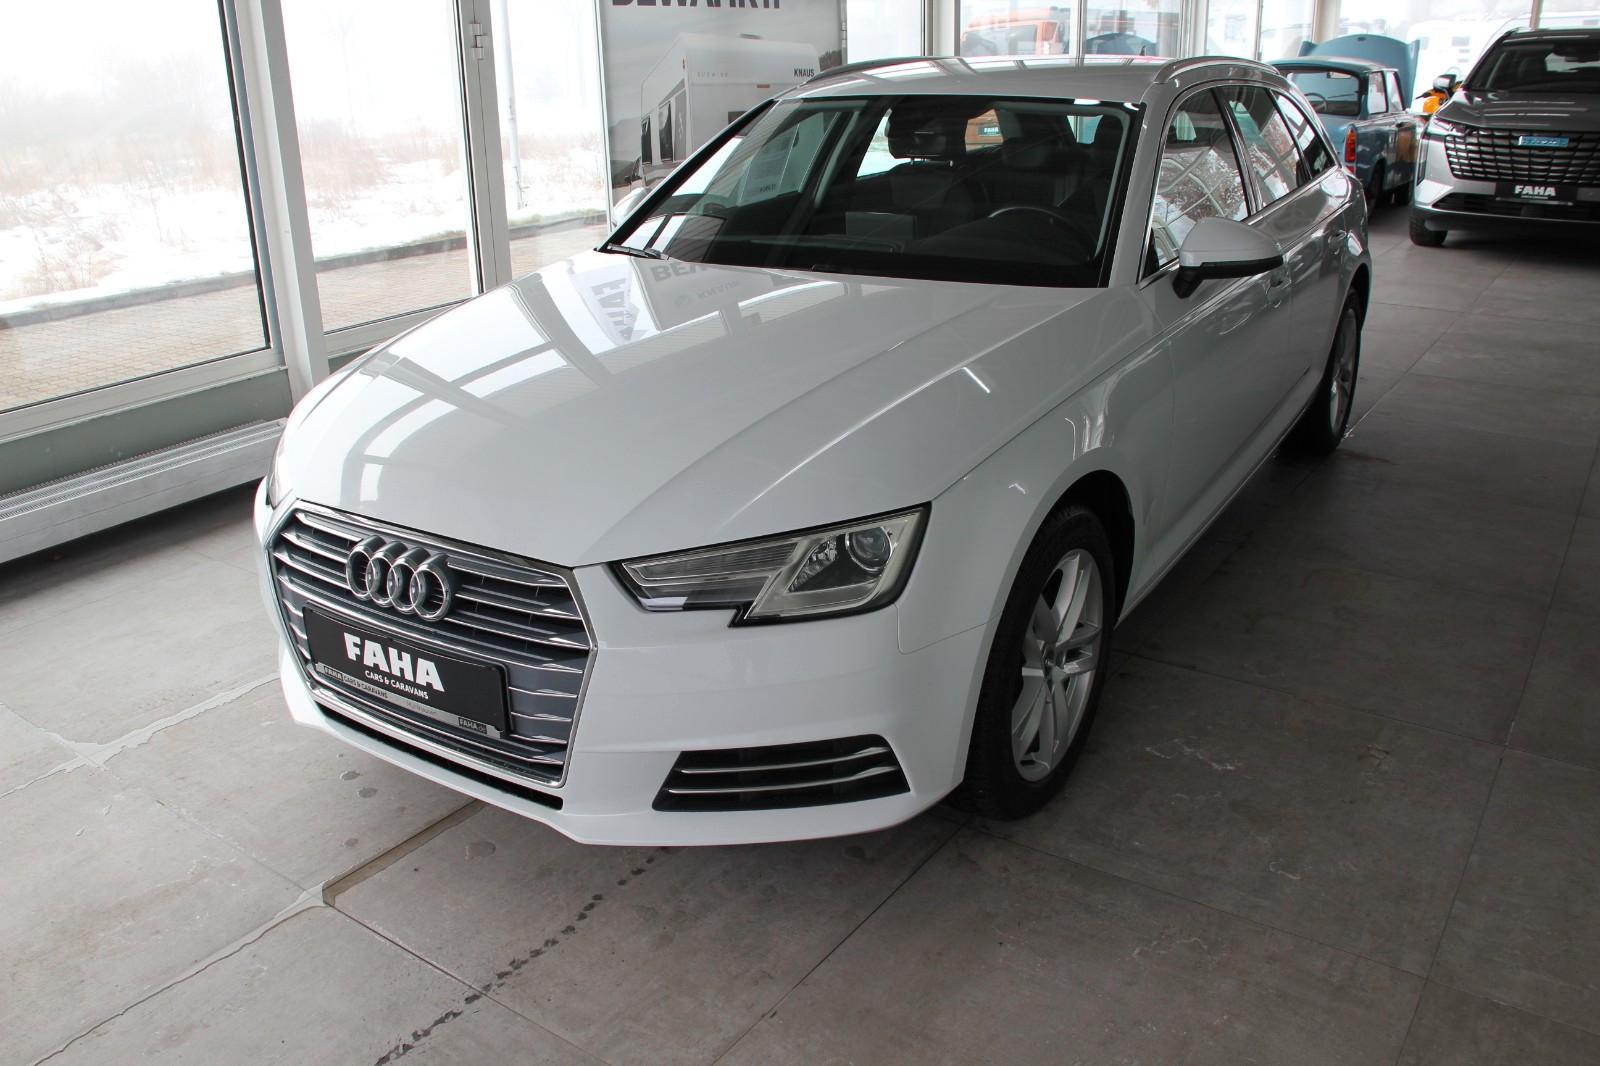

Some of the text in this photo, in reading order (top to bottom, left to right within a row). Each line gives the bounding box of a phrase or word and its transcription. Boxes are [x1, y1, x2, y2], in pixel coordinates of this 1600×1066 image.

[794, 68, 815, 77] KNAUS
[1514, 184, 1557, 197] FAHA
[343, 632, 445, 692] FAHA
[365, 670, 429, 699] CARS & CARAVANS
